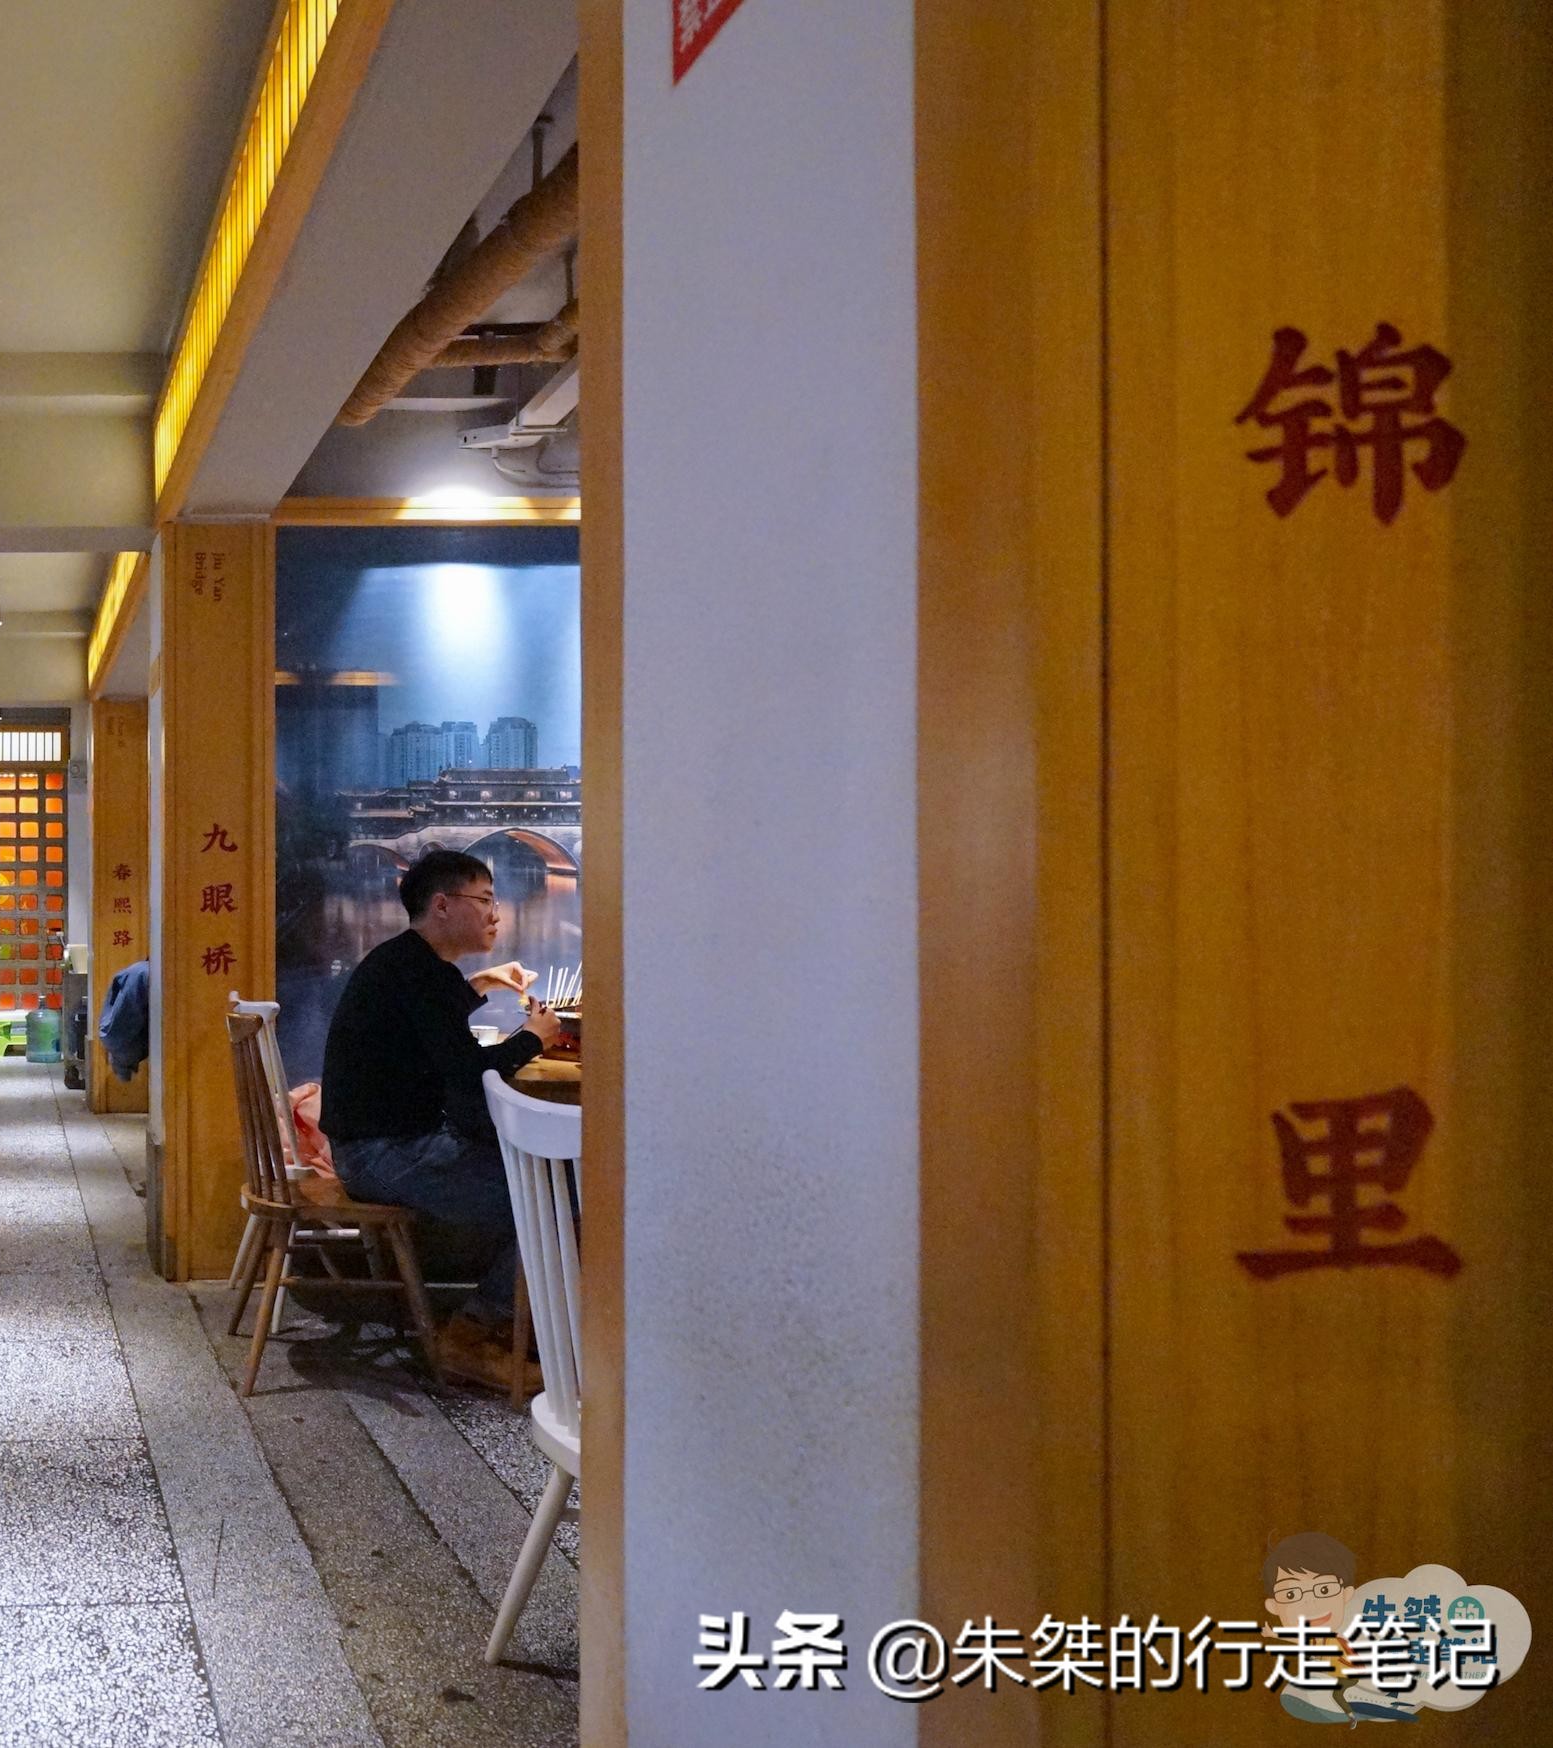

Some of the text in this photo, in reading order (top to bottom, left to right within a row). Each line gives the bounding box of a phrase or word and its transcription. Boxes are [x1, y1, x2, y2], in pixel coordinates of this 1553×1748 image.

[191, 551, 207, 596] Bridge
[1235, 322, 1467, 1282] 锦里
[112, 863, 134, 949] 春熙路
[200, 822, 239, 976] 九眼桥
